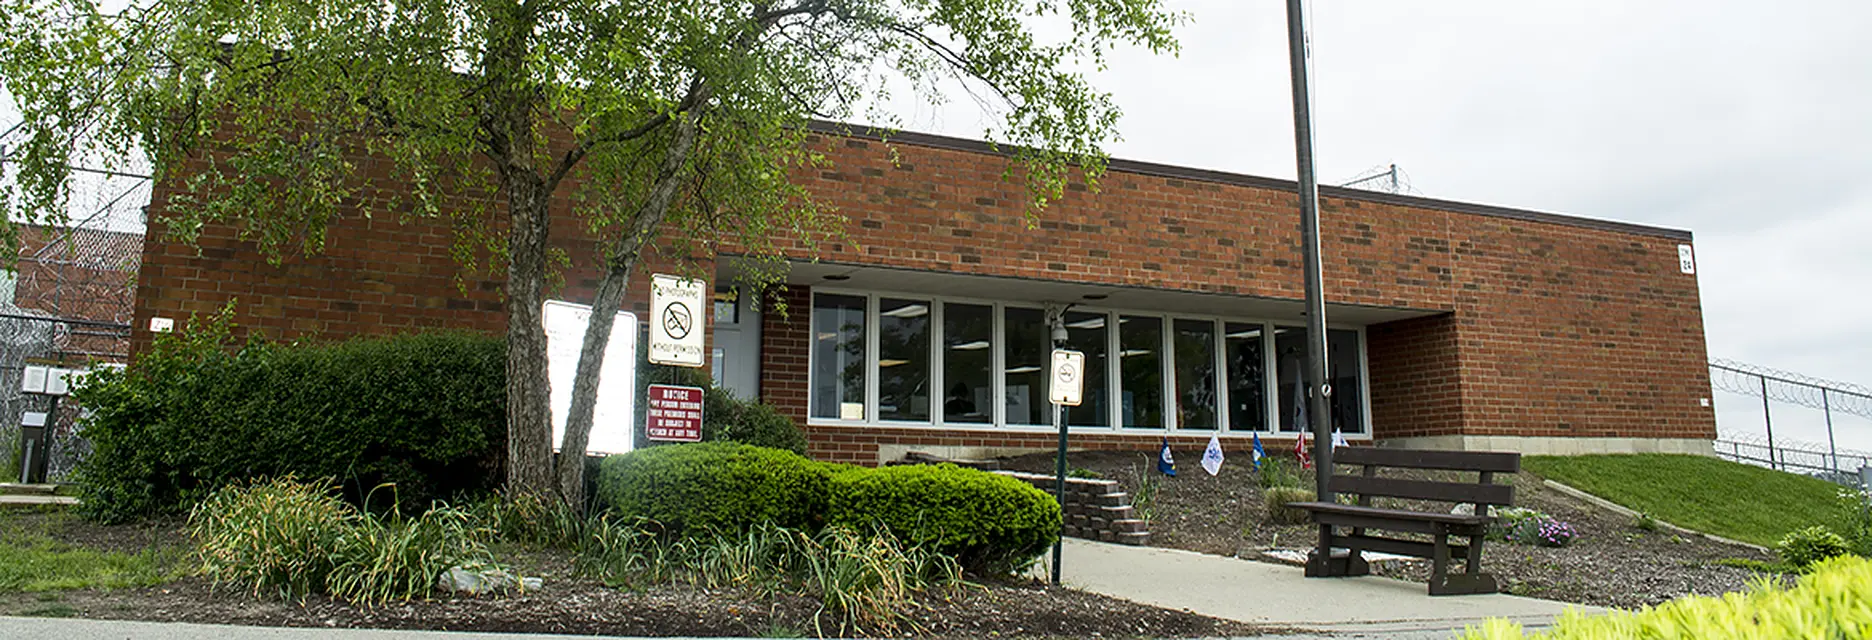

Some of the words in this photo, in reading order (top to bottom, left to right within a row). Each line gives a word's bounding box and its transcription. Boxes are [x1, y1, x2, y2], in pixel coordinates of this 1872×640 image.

[673, 343, 701, 356] PERMISSION
[663, 389, 689, 400] NOTICE
[661, 400, 678, 408] PERSON
[680, 402, 700, 410] ENTERING
[650, 408, 663, 417] THESE
[664, 410, 686, 418] PREMISES
[687, 411, 700, 419] SHALL
[657, 418, 664, 427] BE
[665, 419, 684, 427] SUBJECT
[686, 420, 692, 428] TO
[650, 428, 667, 437] SEARCH
[668, 428, 674, 437] AT
[675, 429, 684, 437] ANY
